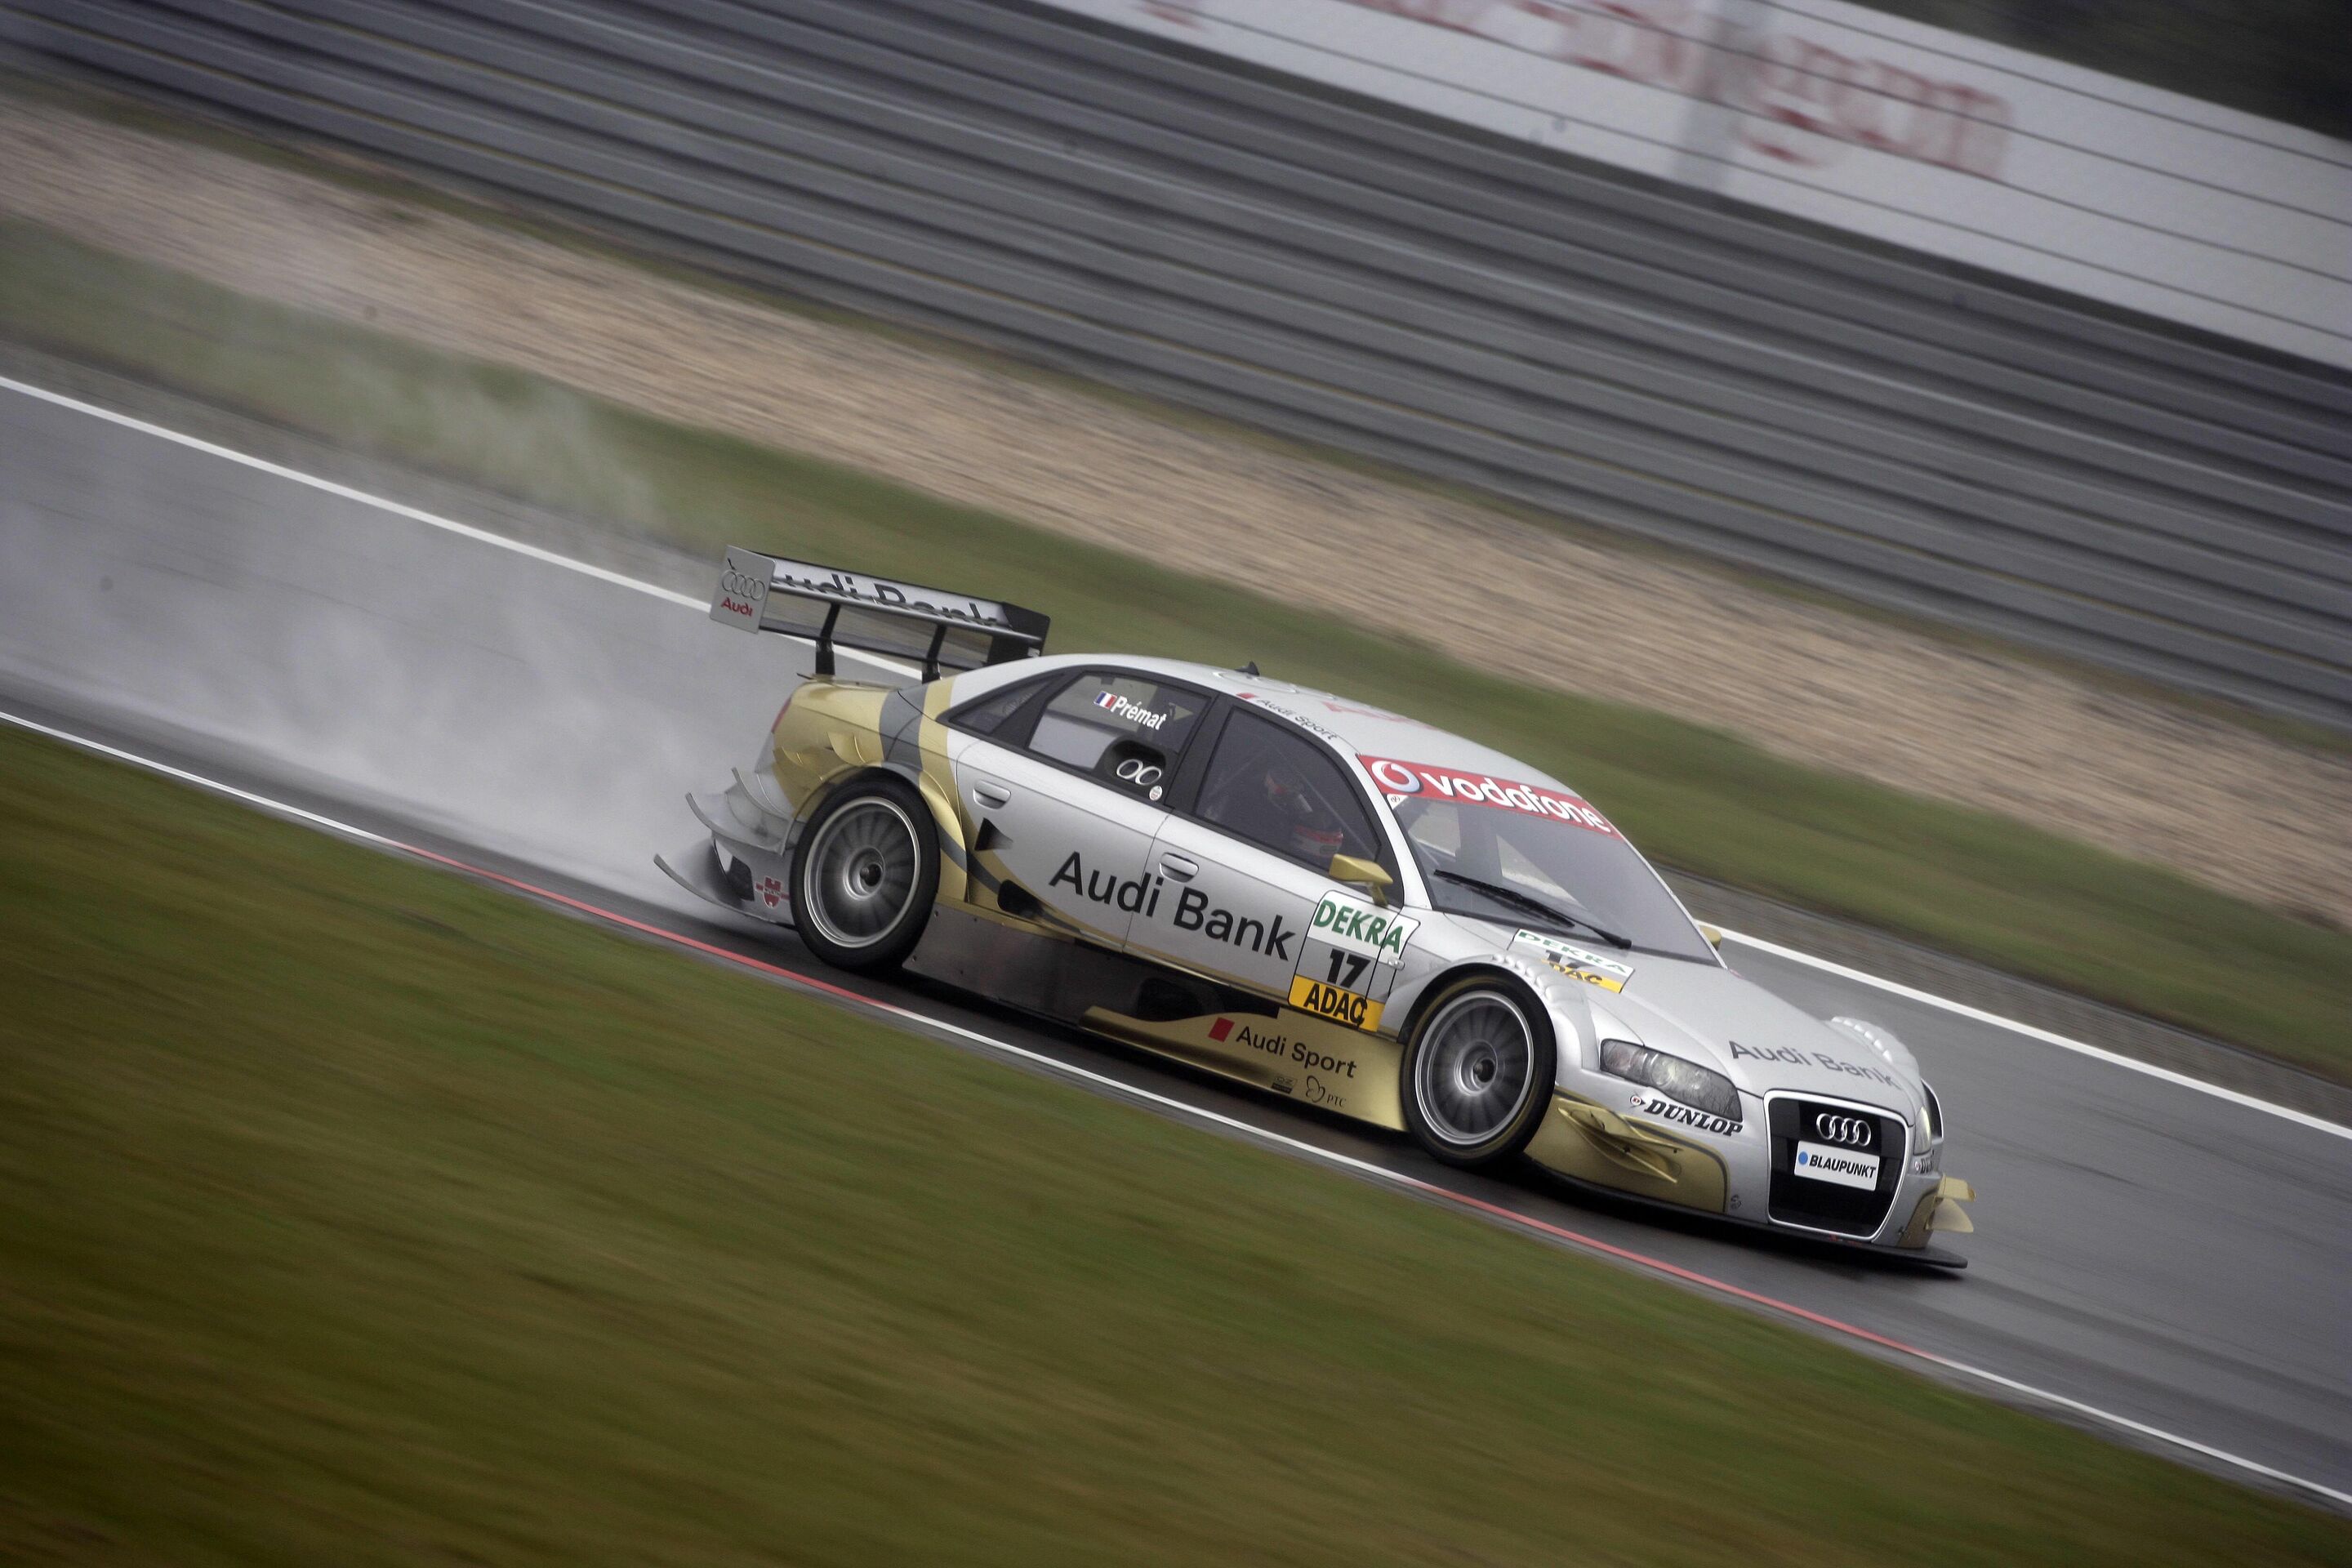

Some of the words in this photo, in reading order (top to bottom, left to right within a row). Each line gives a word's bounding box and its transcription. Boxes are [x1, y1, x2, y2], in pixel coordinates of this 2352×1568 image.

[720, 596, 754, 617] Audi
[1111, 694, 1169, 731] Prémat
[1294, 715, 1338, 740] Sport
[1419, 771, 1612, 834] vodafone
[1049, 851, 1164, 919] Audi
[1173, 886, 1296, 962] Bank
[1312, 898, 1404, 955] DEKRA
[1326, 949, 1374, 989] 17
[1518, 931, 1628, 973] DEKRA
[1303, 982, 1369, 1028] ADAC
[1236, 1026, 1285, 1057] Audi
[1291, 1042, 1357, 1079] Sport
[1729, 1040, 1812, 1066] Audi
[1811, 1052, 1903, 1091] Bank
[1326, 1094, 1347, 1107] PTC
[1643, 1098, 1744, 1137] DUNLOP
[1809, 1154, 1877, 1179] BLAUPUNKT
